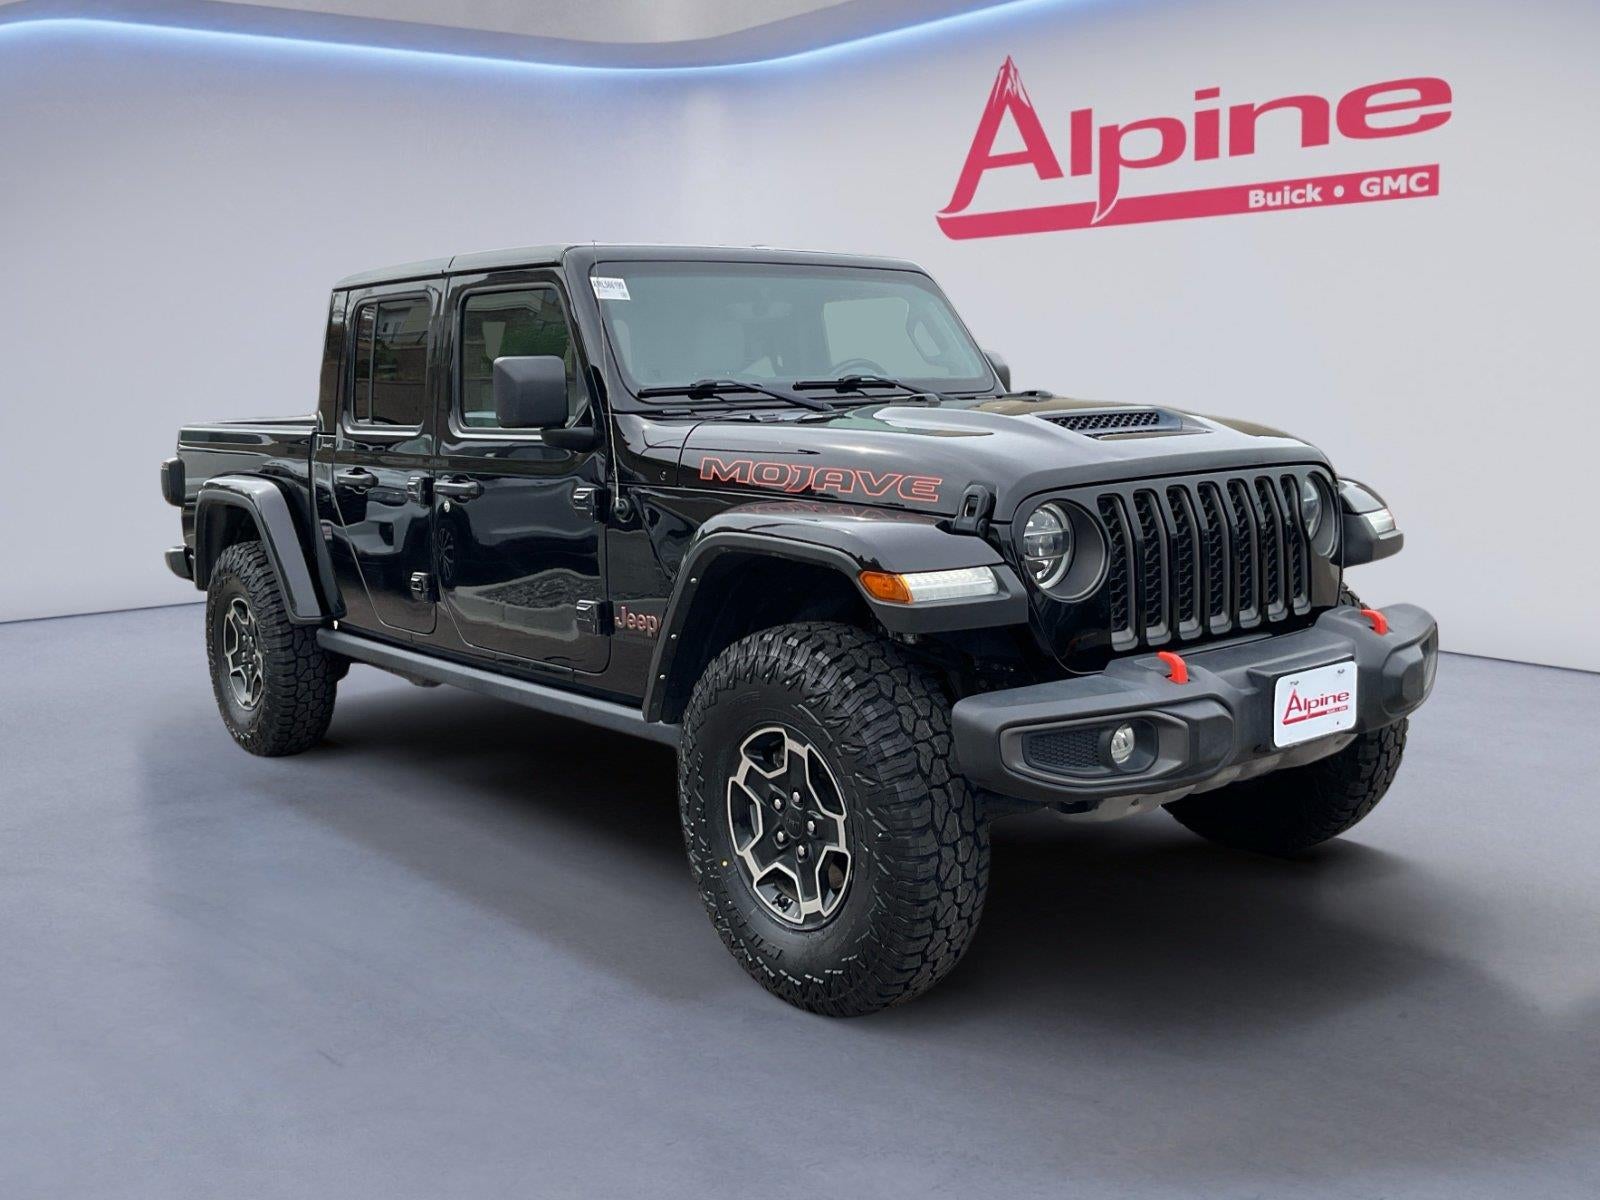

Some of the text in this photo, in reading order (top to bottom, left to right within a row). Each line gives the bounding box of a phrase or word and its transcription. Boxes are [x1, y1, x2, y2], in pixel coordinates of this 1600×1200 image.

[937, 54, 1453, 224] Alpine
[1248, 172, 1430, 209] Buick GMC
[700, 457, 943, 502] MOJAVE
[614, 606, 659, 638] Jeep
[1283, 688, 1350, 720] Alpine
